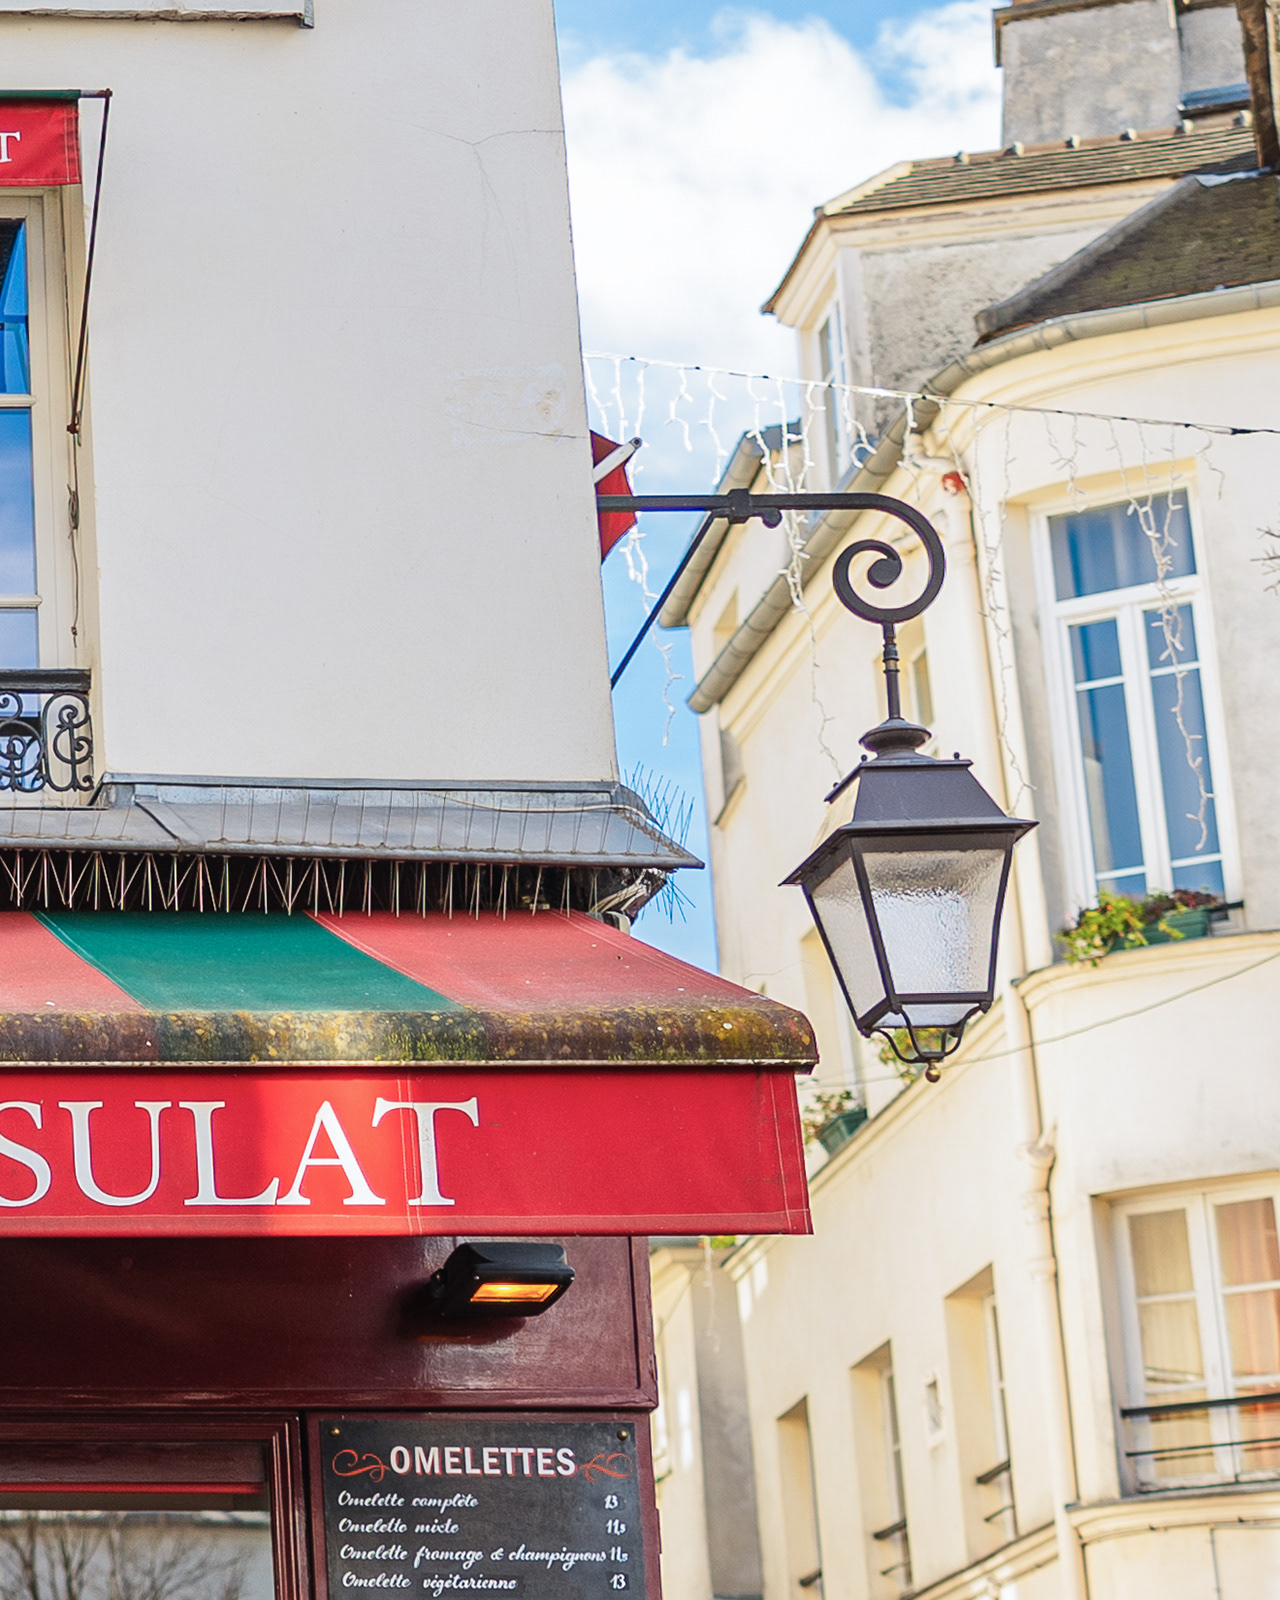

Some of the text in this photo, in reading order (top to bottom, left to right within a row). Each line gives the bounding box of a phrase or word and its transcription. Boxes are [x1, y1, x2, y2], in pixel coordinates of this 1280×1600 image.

[390, 1446, 578, 1477] OMELETTES
[338, 1490, 618, 1513] Omelette complète 13
[339, 1518, 407, 1533] Omelette
[415, 1520, 459, 1533] mixte
